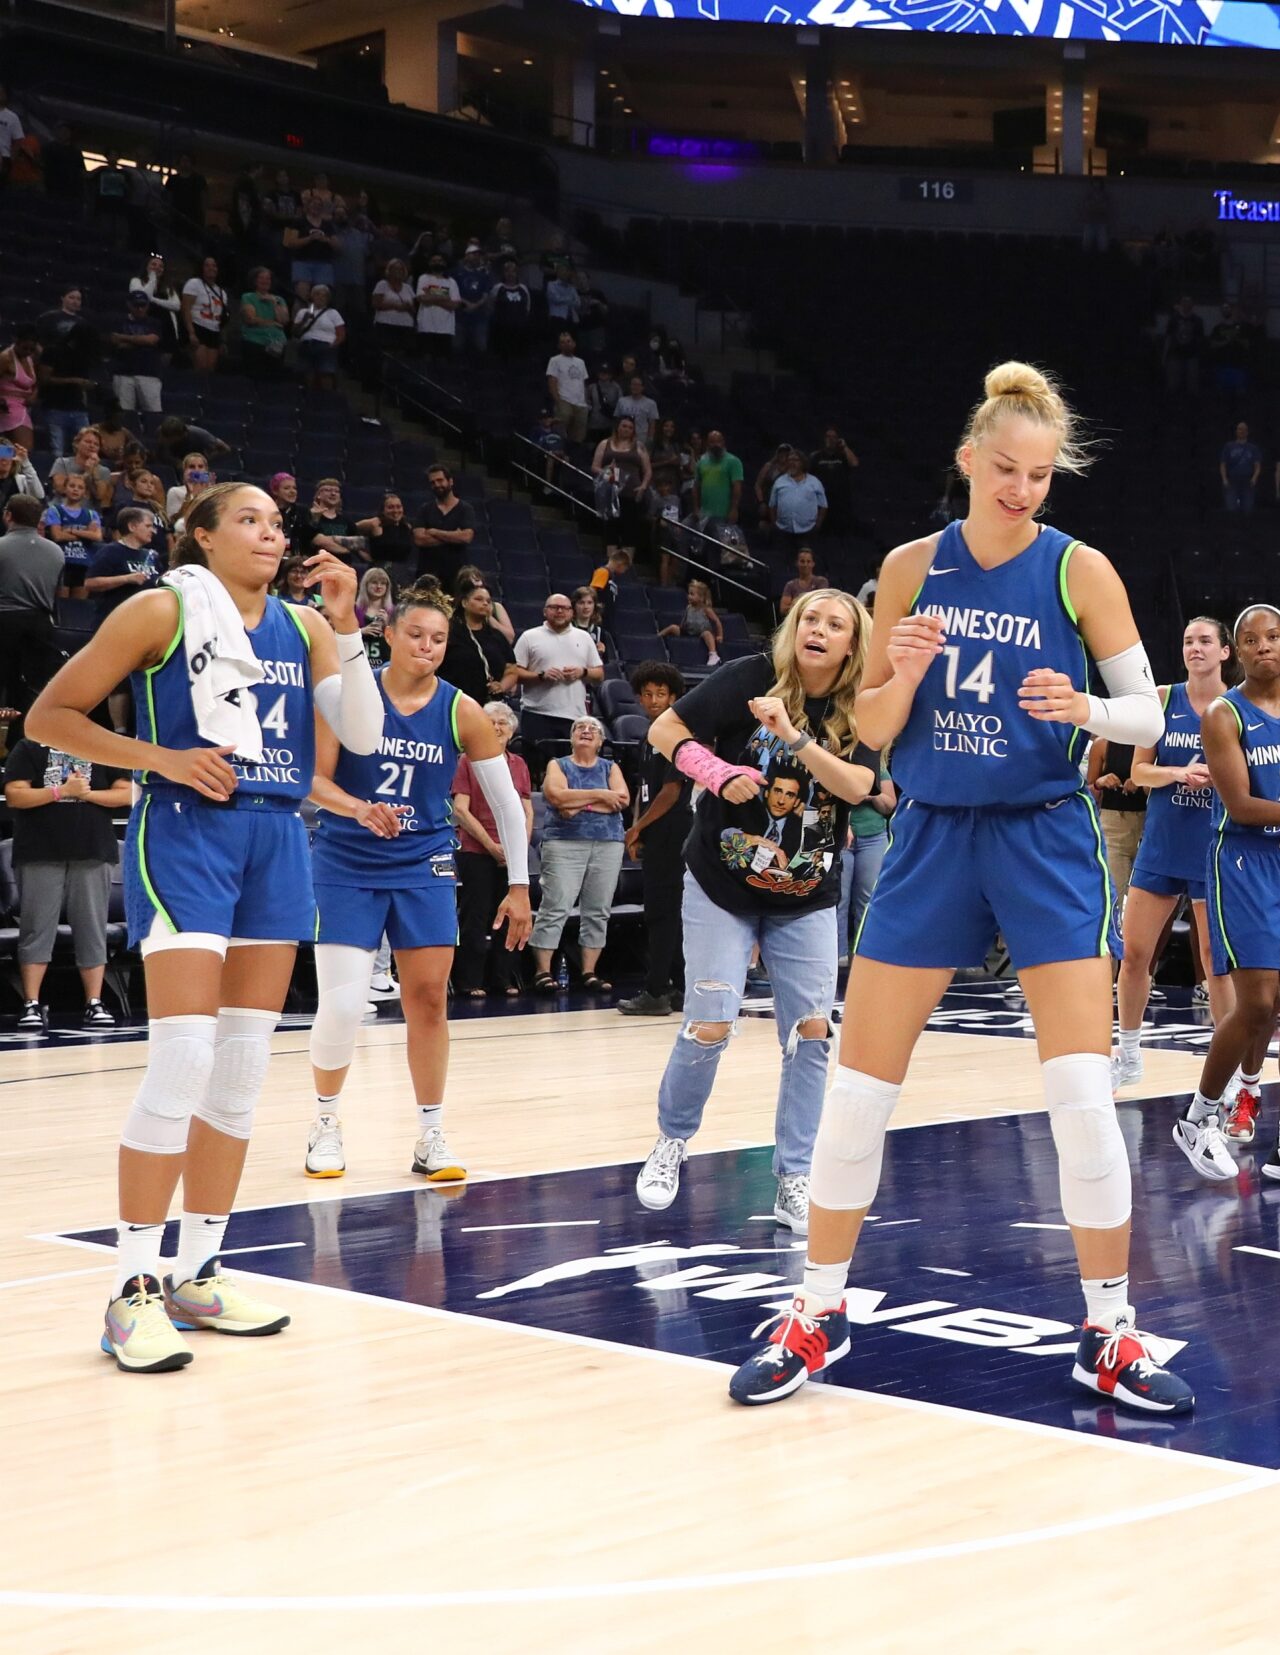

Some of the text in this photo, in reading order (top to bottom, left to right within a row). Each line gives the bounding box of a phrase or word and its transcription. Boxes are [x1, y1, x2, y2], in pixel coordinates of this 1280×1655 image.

[919, 181, 955, 199] 116
[943, 644, 996, 704] 14
[933, 709, 1002, 735] MAYO
[933, 731, 1008, 758] CLINIC
[375, 761, 416, 798] 21
[1176, 784, 1212, 796] MAYO
